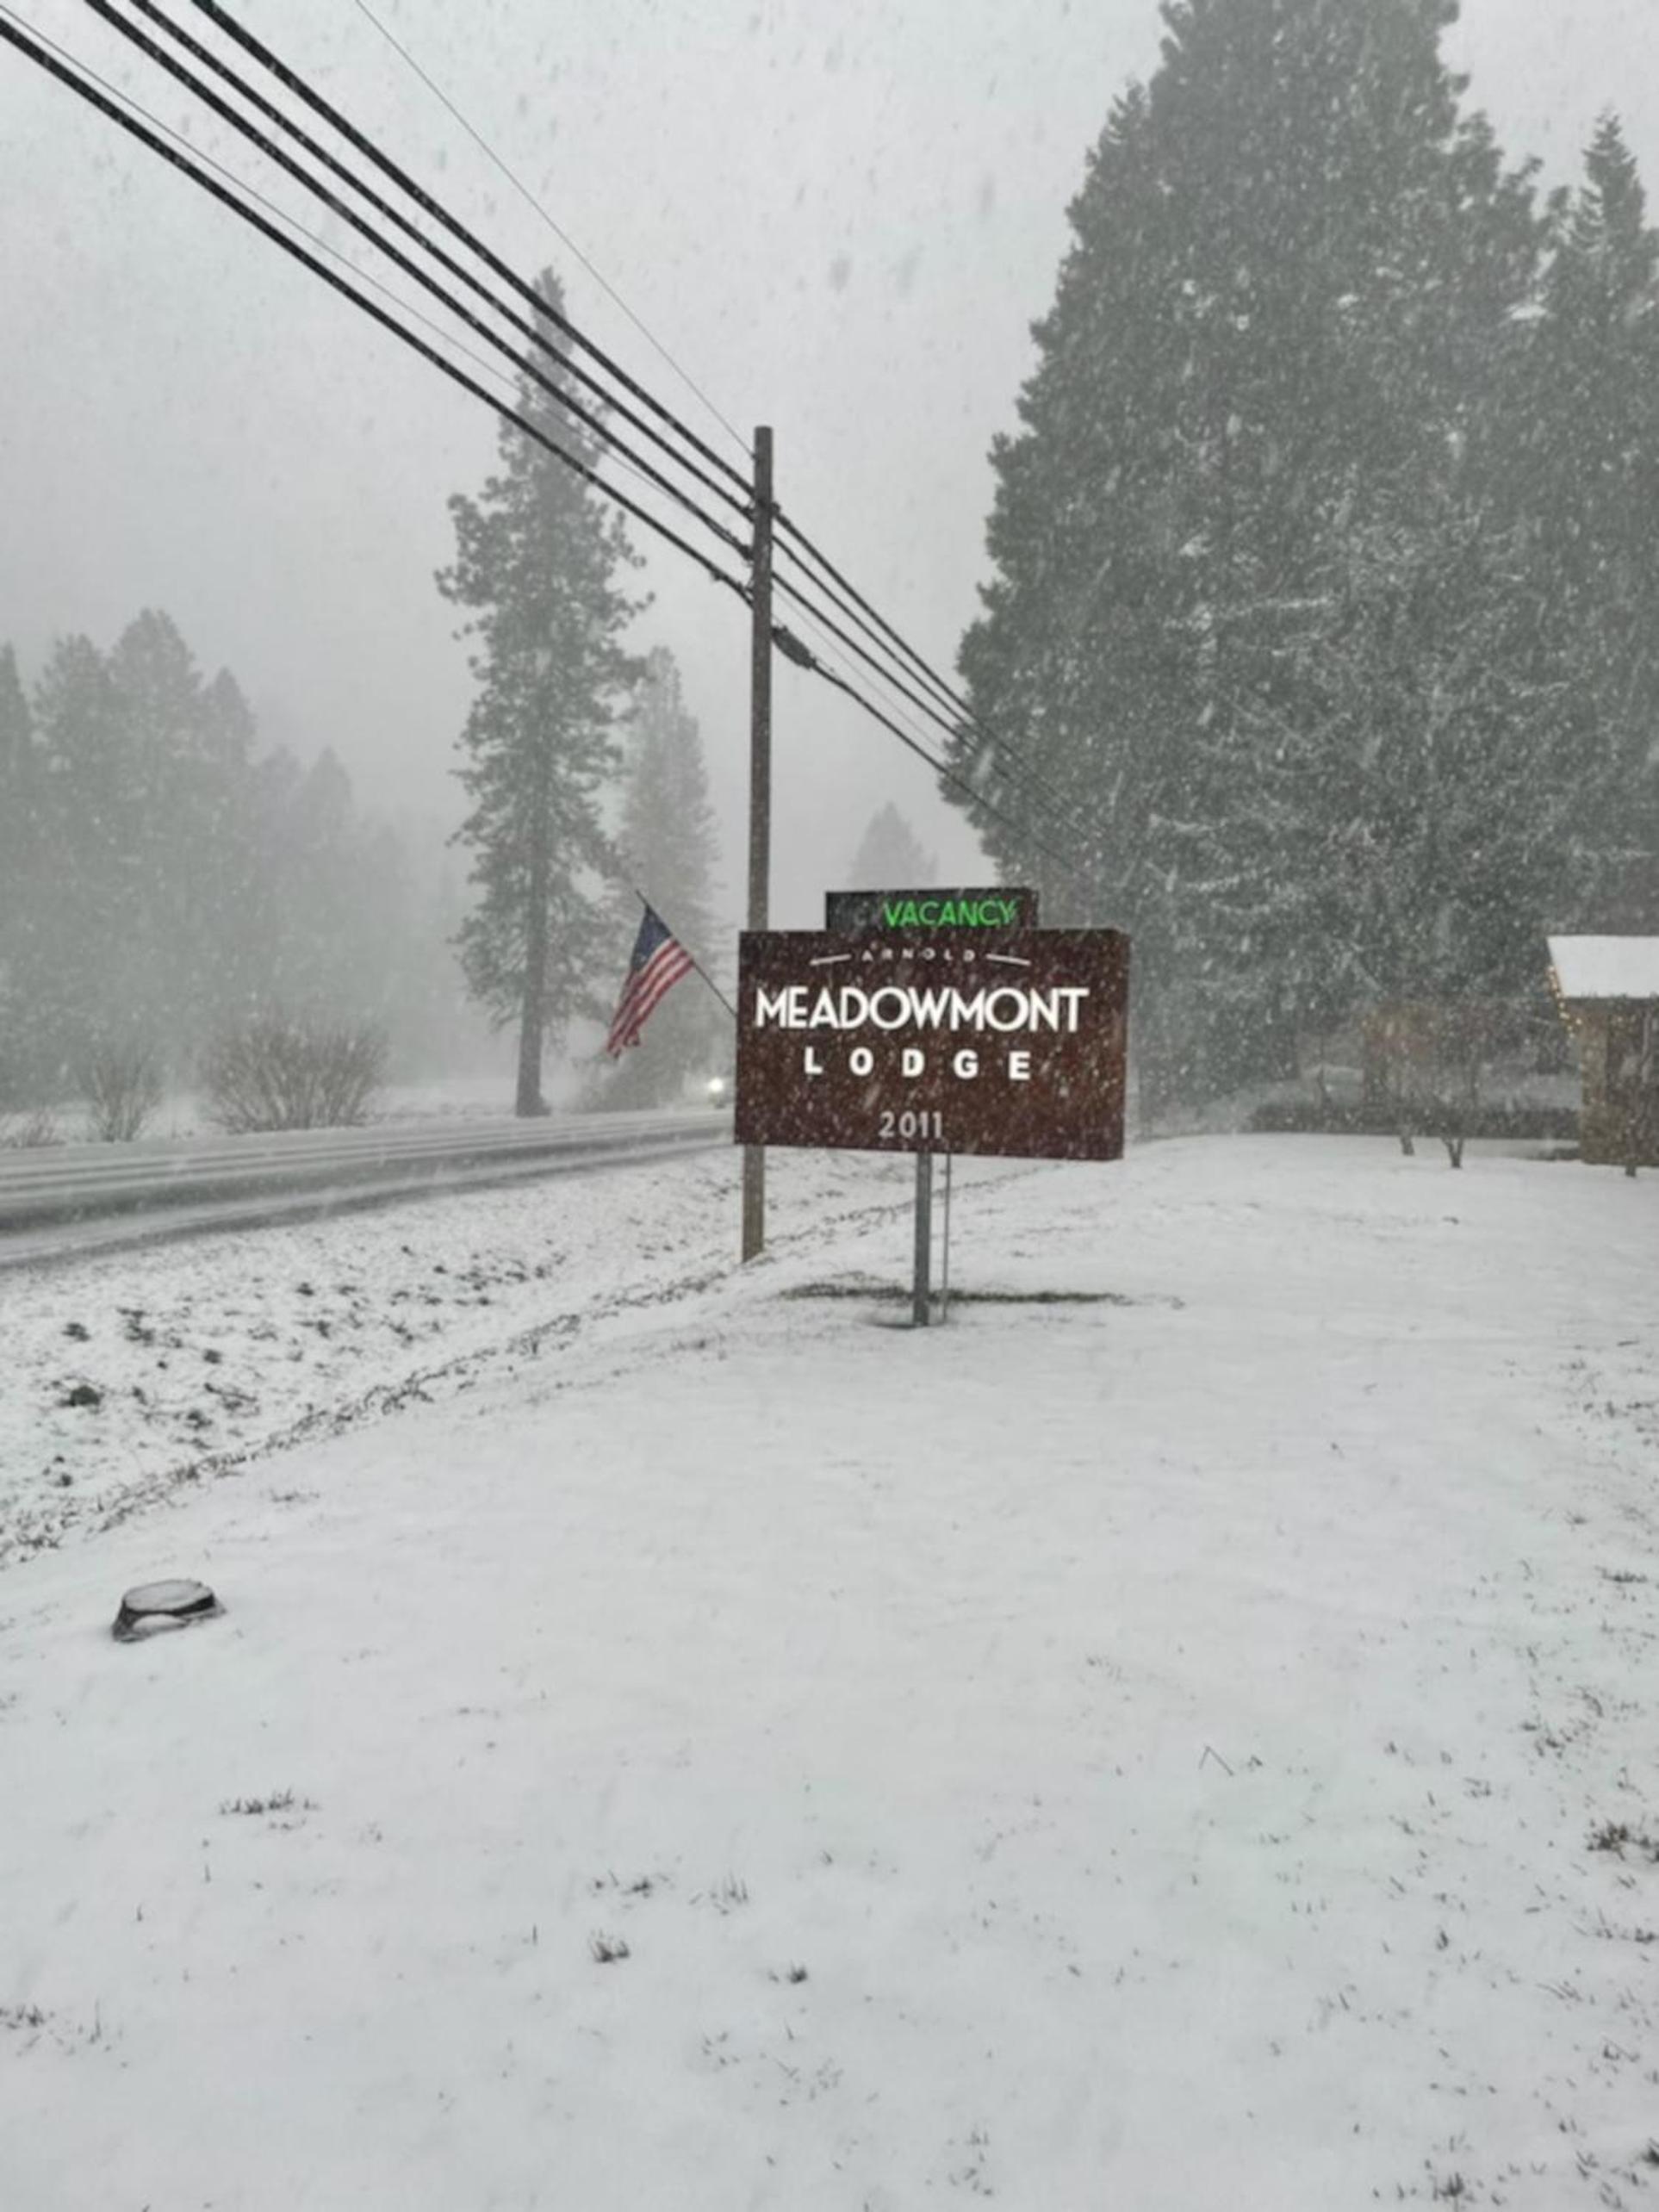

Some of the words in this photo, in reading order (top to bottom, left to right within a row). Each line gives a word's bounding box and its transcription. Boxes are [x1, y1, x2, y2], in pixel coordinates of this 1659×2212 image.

[884, 898, 1017, 928] VACANCY
[862, 948, 975, 961] ARNOLD
[755, 986, 1090, 1032] MEADOWMONT
[805, 1047, 1031, 1080] LODGE
[879, 1111, 942, 1138] 2011
